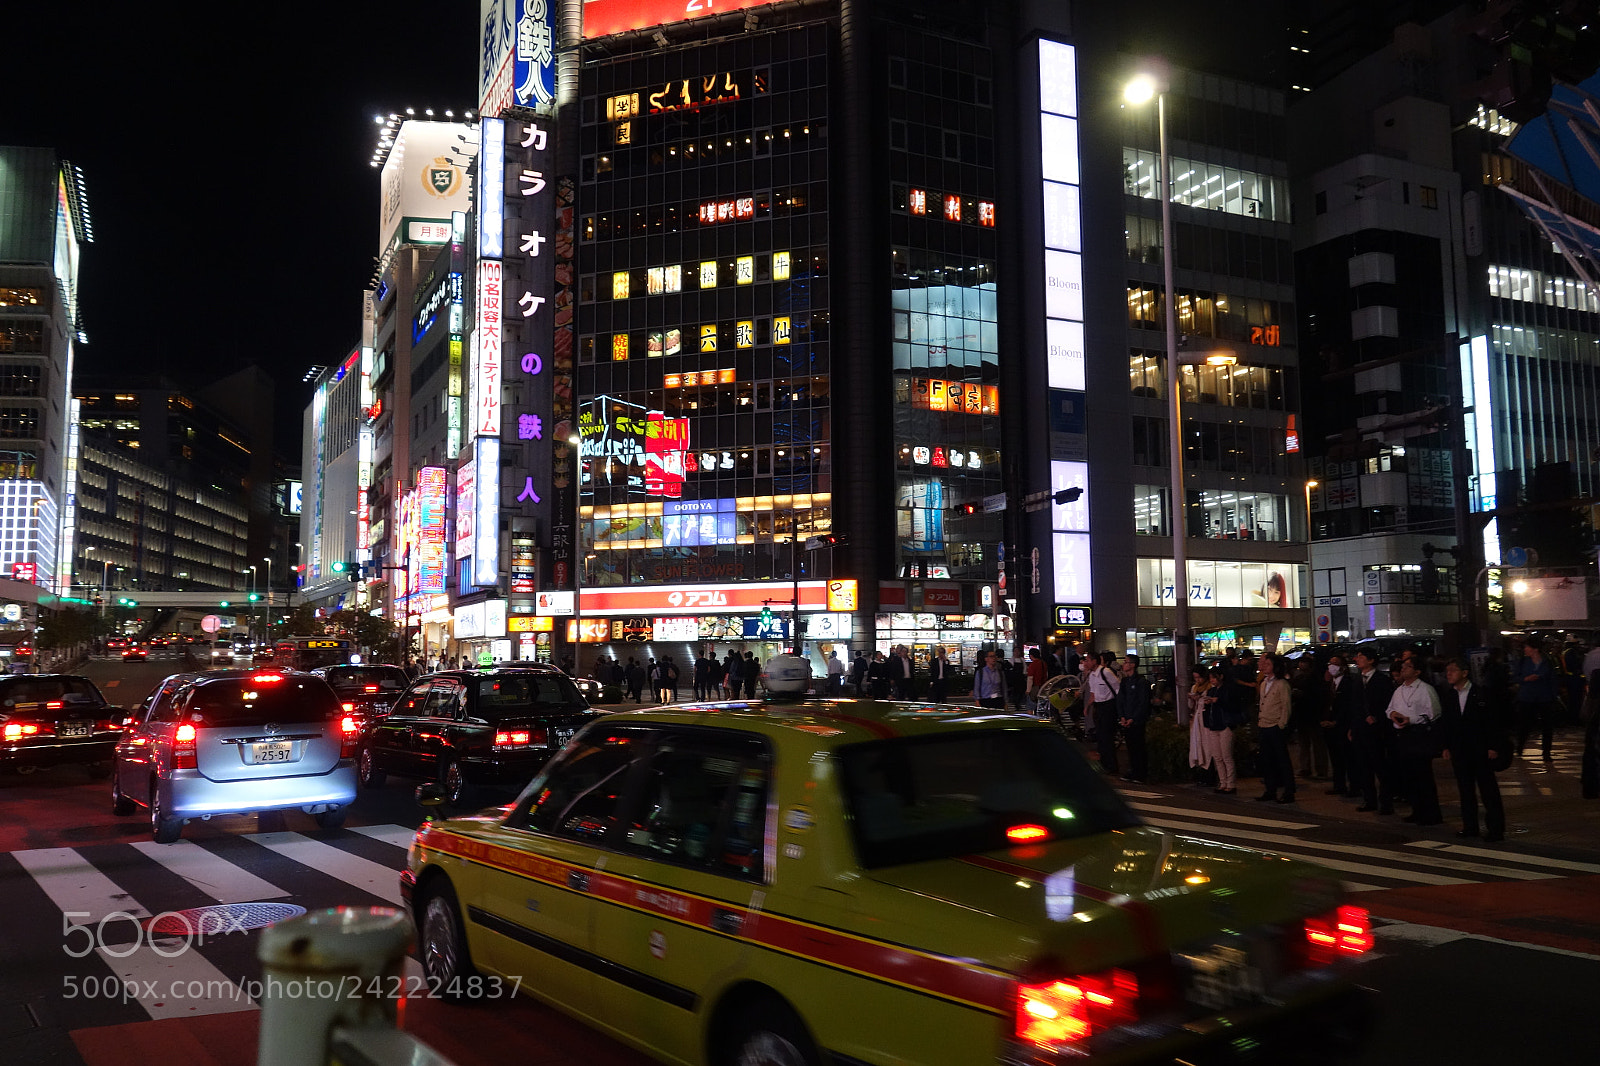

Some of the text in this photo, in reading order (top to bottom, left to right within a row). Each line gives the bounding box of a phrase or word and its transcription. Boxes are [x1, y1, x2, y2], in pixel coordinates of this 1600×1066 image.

[701, 256, 789, 282] 松阪牛
[1048, 275, 1081, 291] Bloom
[516, 123, 547, 504] カラオケの鉄人
[701, 319, 791, 349] 六歌仙
[481, 262, 501, 433] 100名収容大パーティールーム
[613, 335, 628, 361] 焼肉
[1049, 345, 1083, 360] Bloom
[917, 379, 943, 396] 5F
[674, 502, 713, 512] OOTOYA
[654, 563, 745, 579] SUN FLOWER
[685, 590, 728, 606] アコム
[1319, 597, 1342, 606] SHOP
[261, 749, 291, 761] 25-97
